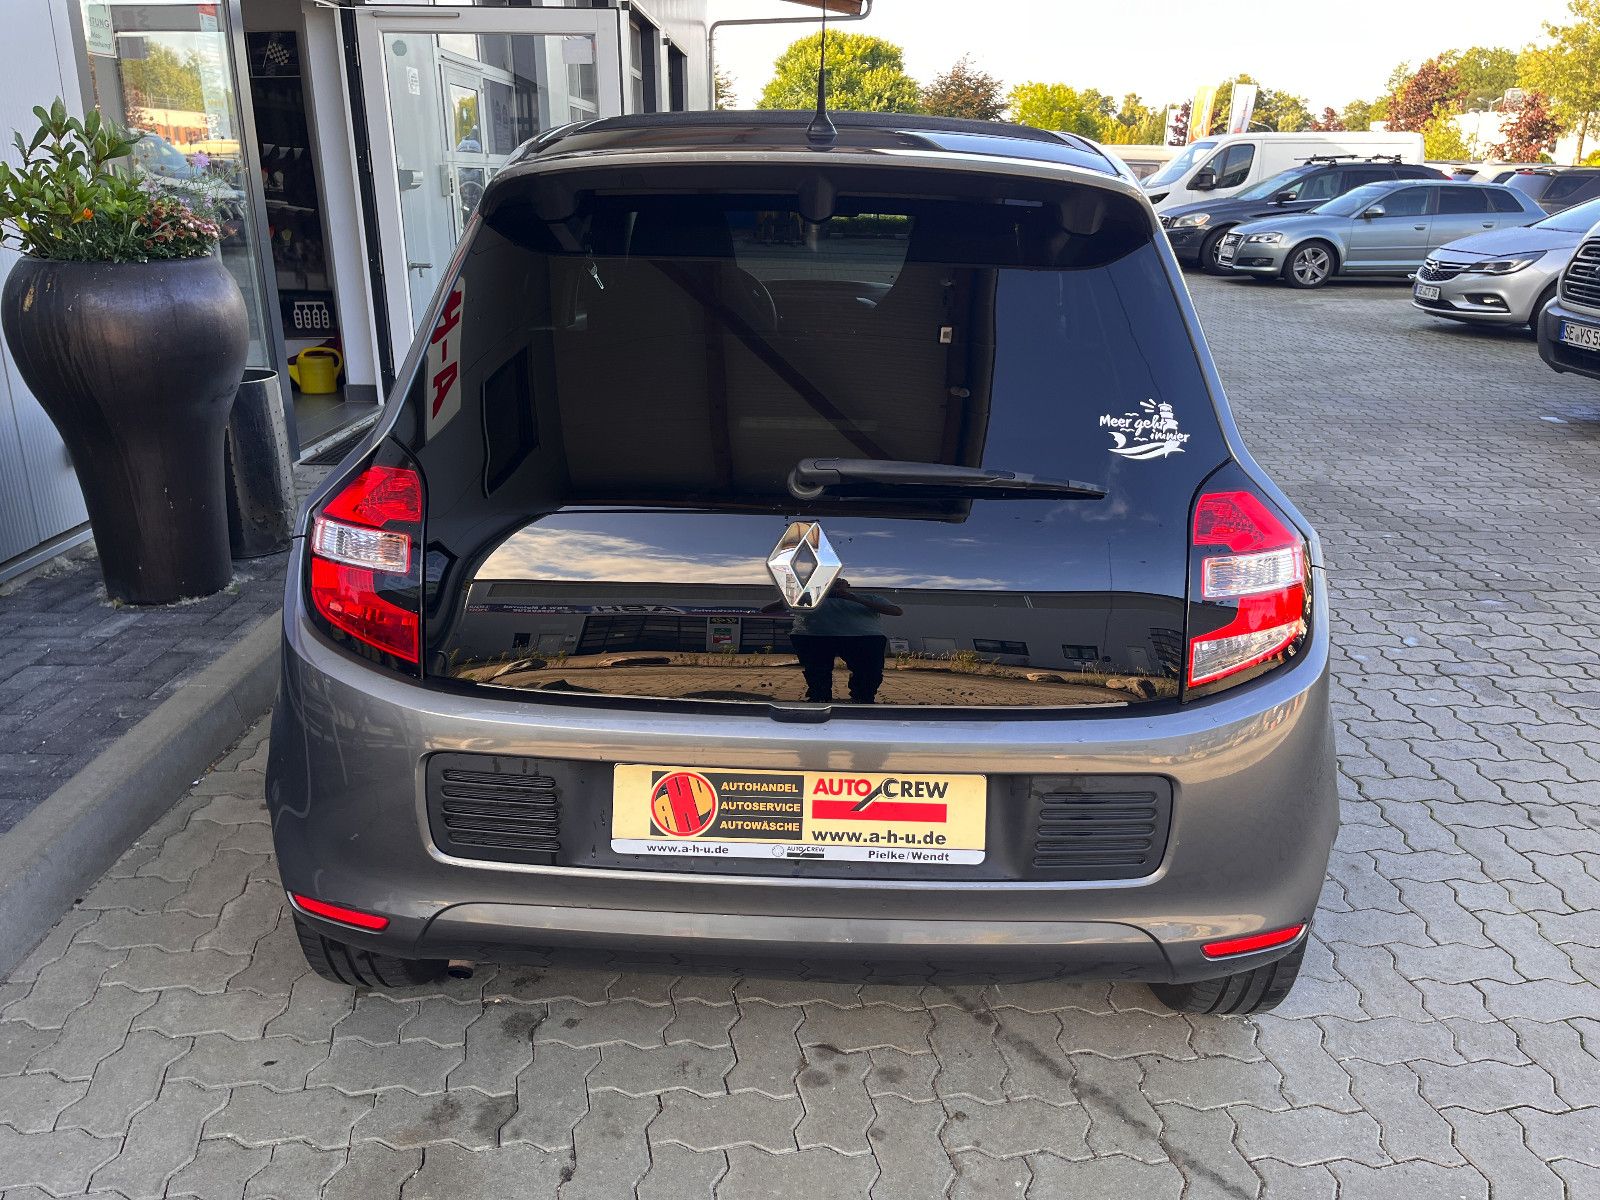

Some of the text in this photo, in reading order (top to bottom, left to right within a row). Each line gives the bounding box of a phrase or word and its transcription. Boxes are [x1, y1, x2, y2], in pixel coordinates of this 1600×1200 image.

[1099, 414, 1133, 428] Meer
[721, 781, 799, 793] AUTOHANDEL
[812, 777, 949, 799] AUTO CREW
[720, 801, 801, 812] AUTOSERVICE
[719, 820, 800, 832] AUTOWÄSCHE
[811, 829, 947, 846] www.a-h-u.de
[646, 844, 729, 855] www.a-h-u.de
[867, 849, 950, 862] Pielke/Wendt
